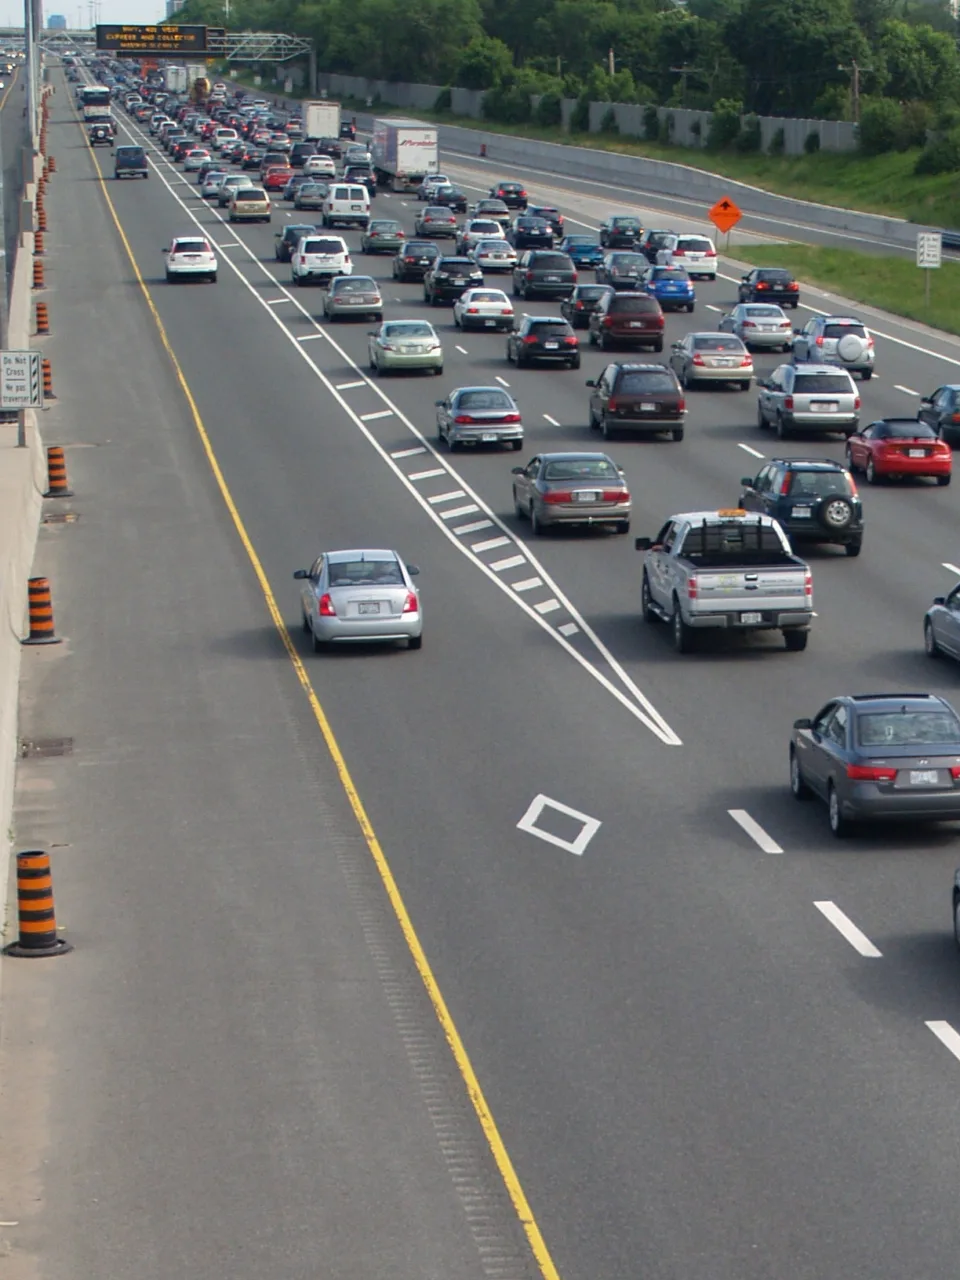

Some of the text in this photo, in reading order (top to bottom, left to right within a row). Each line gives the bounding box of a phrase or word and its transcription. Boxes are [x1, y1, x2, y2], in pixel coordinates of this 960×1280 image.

[3, 356, 27, 364] Do Not
[6, 368, 25, 376] Cross
